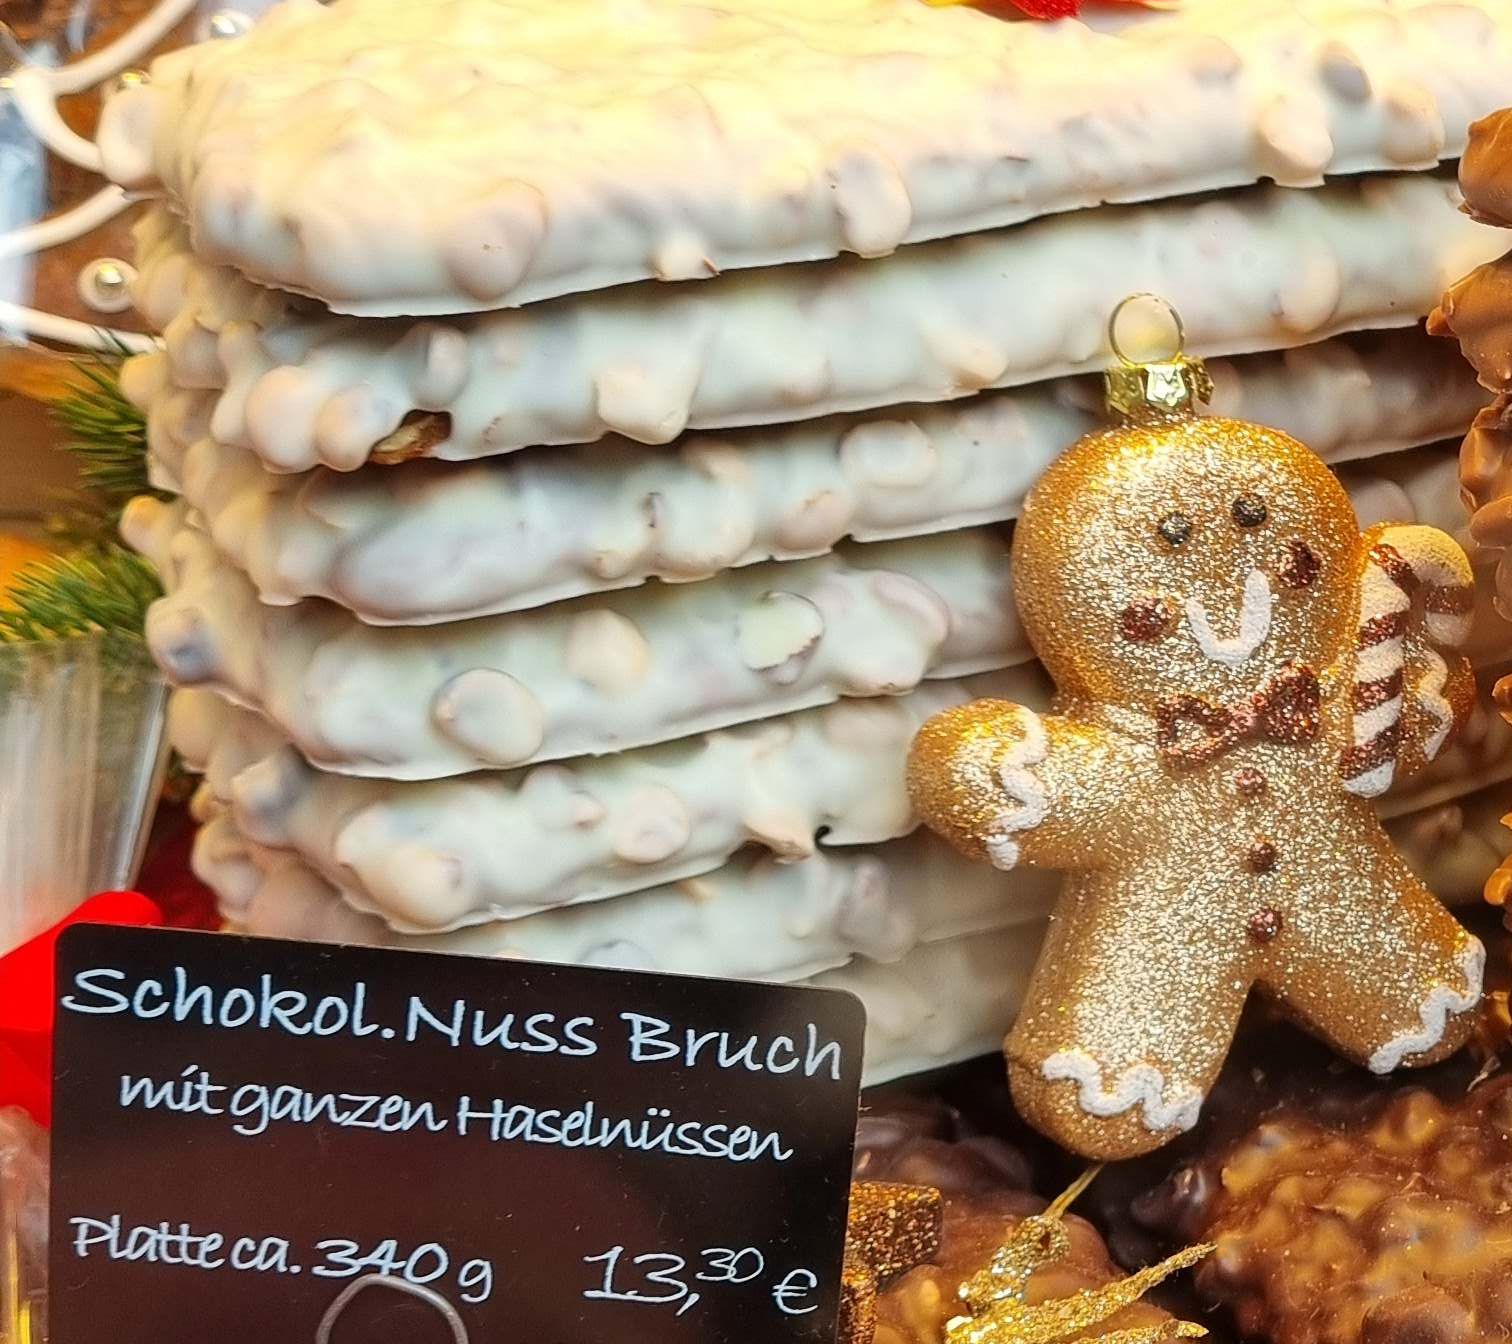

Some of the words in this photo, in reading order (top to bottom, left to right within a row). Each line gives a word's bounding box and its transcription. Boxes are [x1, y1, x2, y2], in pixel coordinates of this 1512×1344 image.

[620, 1011, 842, 1080] Bruch
[119, 1063, 229, 1116] mit
[229, 1080, 449, 1137] ganzen
[456, 1095, 795, 1162] Haselnüssen
[68, 1213, 225, 1270] Platte
[230, 1235, 303, 1276] ca.
[310, 1237, 450, 1285] 340
[456, 1258, 495, 1303] g
[582, 1244, 765, 1317] 13,30
[771, 1267, 820, 1315] €
